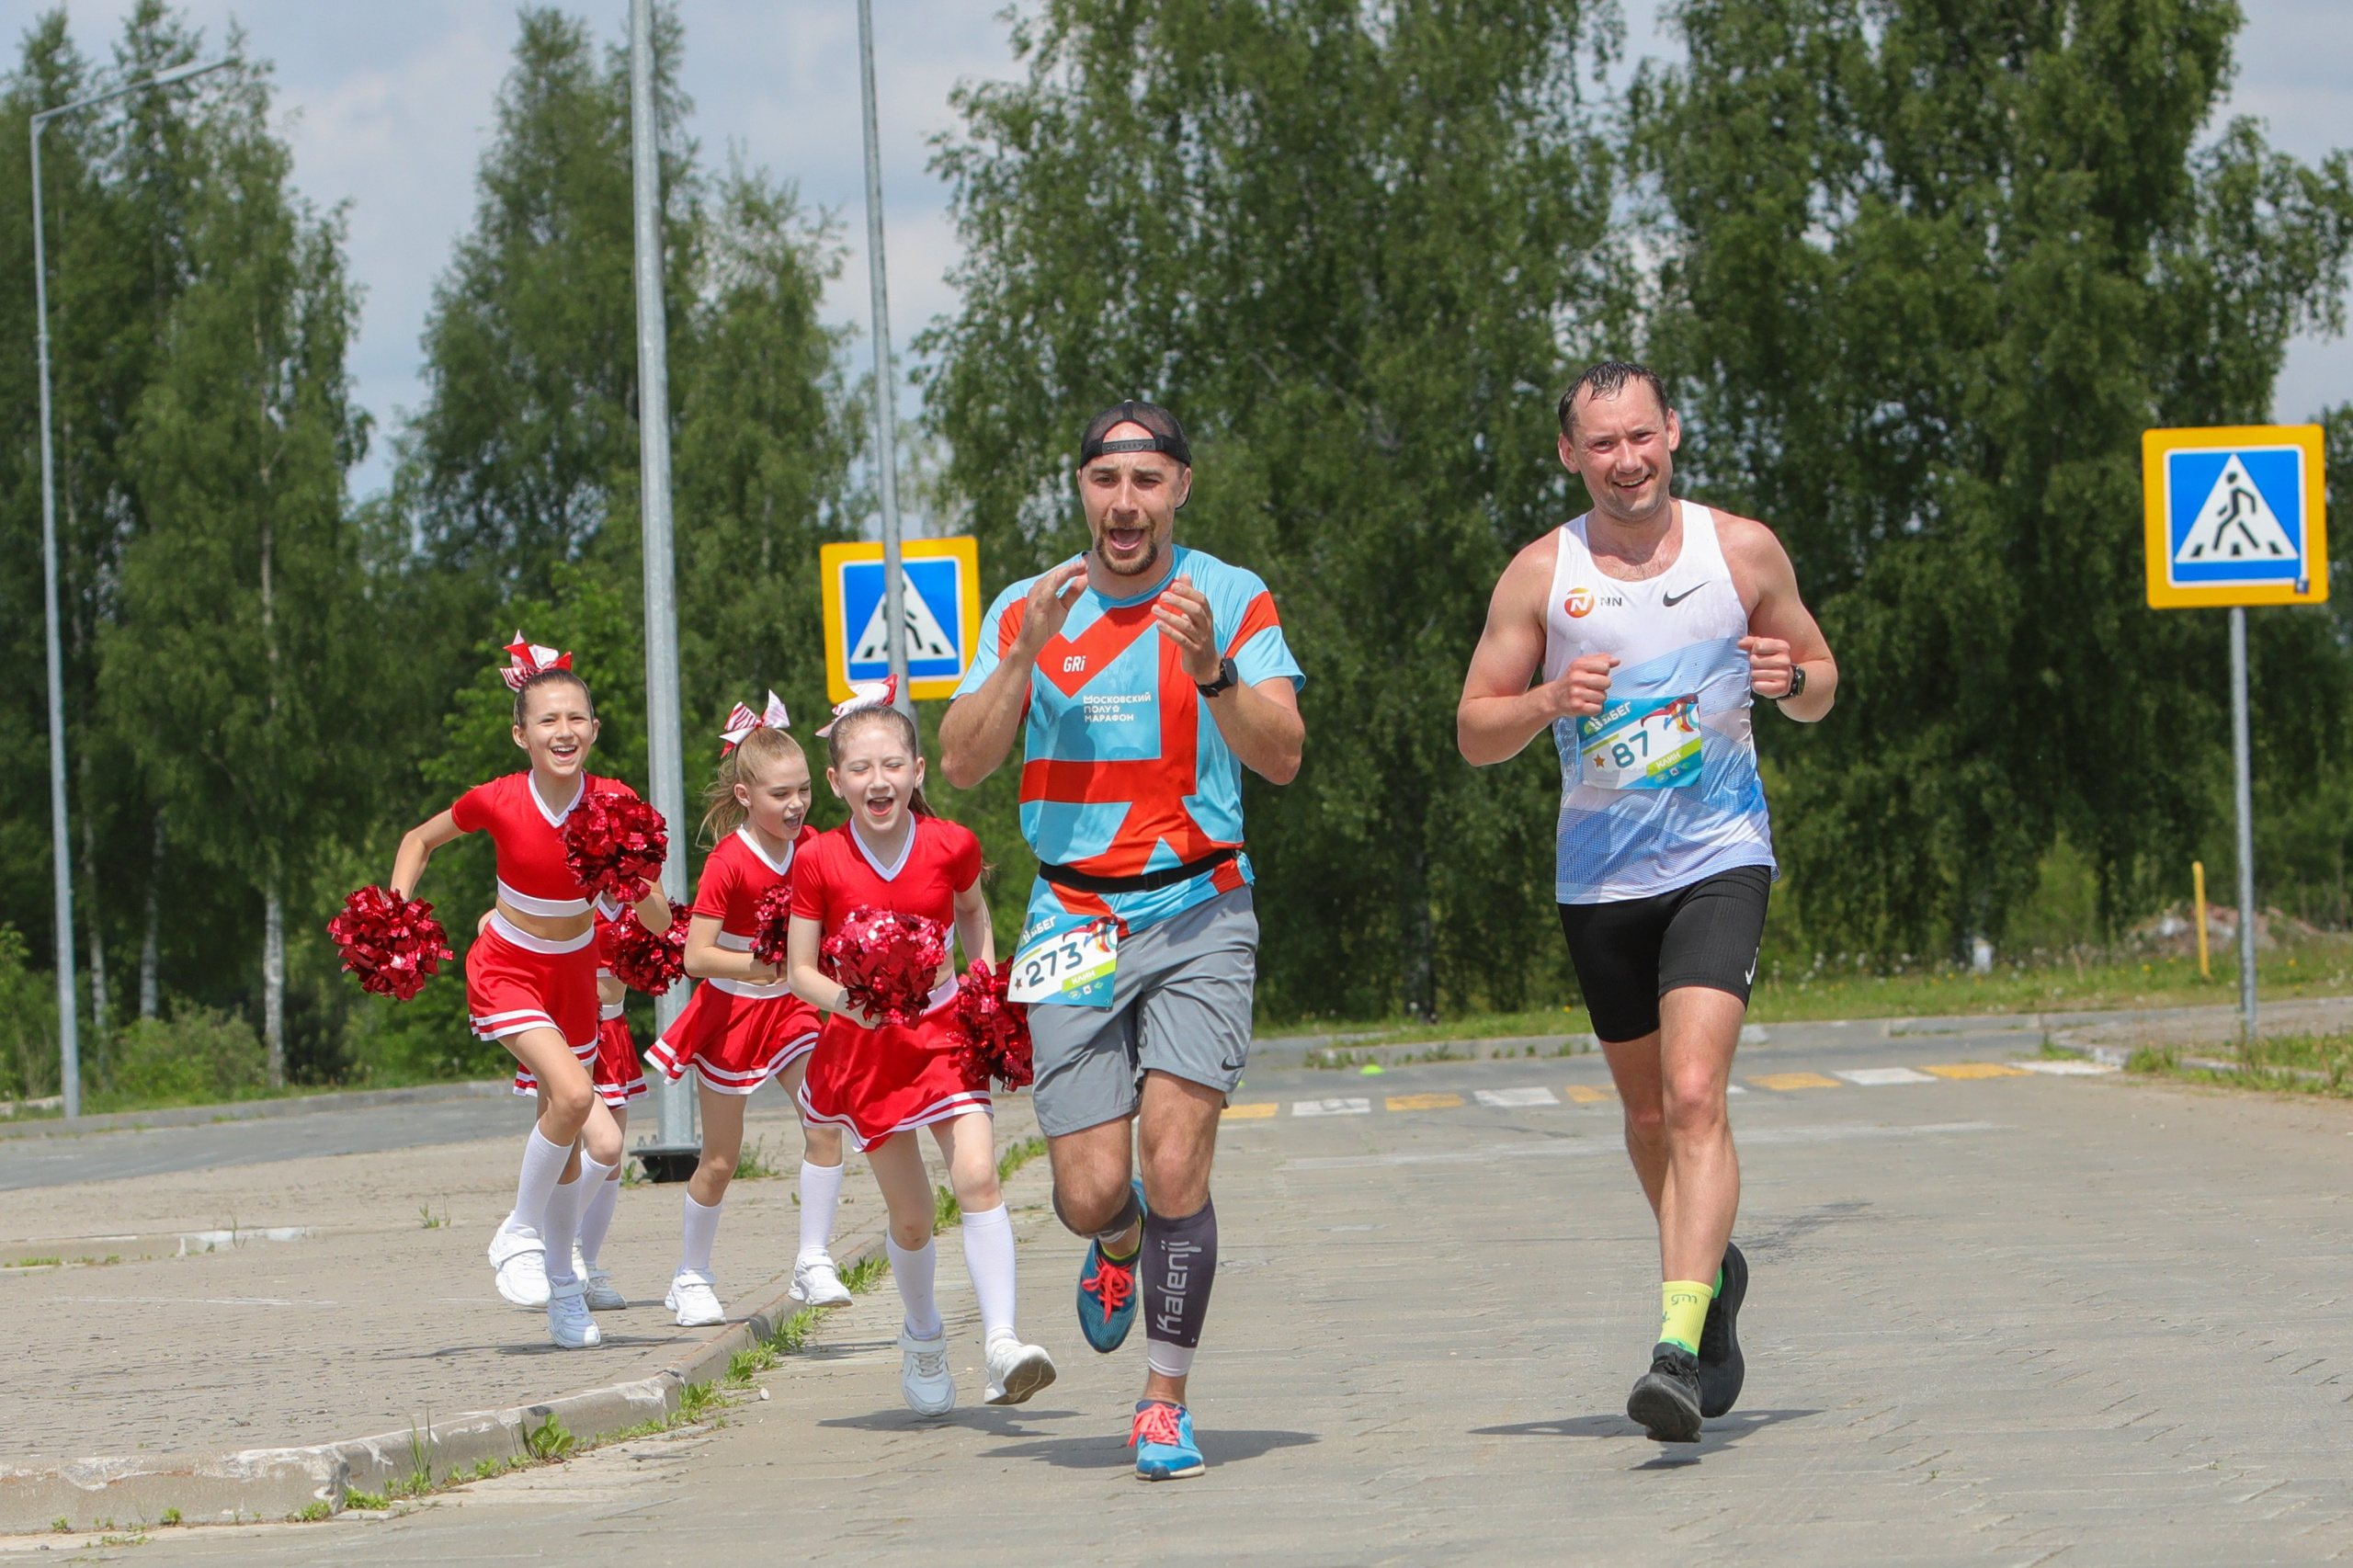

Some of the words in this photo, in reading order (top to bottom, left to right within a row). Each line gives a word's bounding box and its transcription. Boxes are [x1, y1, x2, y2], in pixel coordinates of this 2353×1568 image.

[1063, 655, 1086, 673] GRi
[1083, 691, 1152, 704] МОСКОВСКИЙ
[1084, 705, 1111, 713] ПОЛУ
[1085, 713, 1134, 722] МАРАФОН
[1611, 730, 1648, 768] 87
[1655, 750, 1681, 770] КЛИН
[1026, 941, 1083, 987] 273
[1072, 970, 1097, 985] КЛИН
[1156, 1240, 1201, 1335] Kalenji
